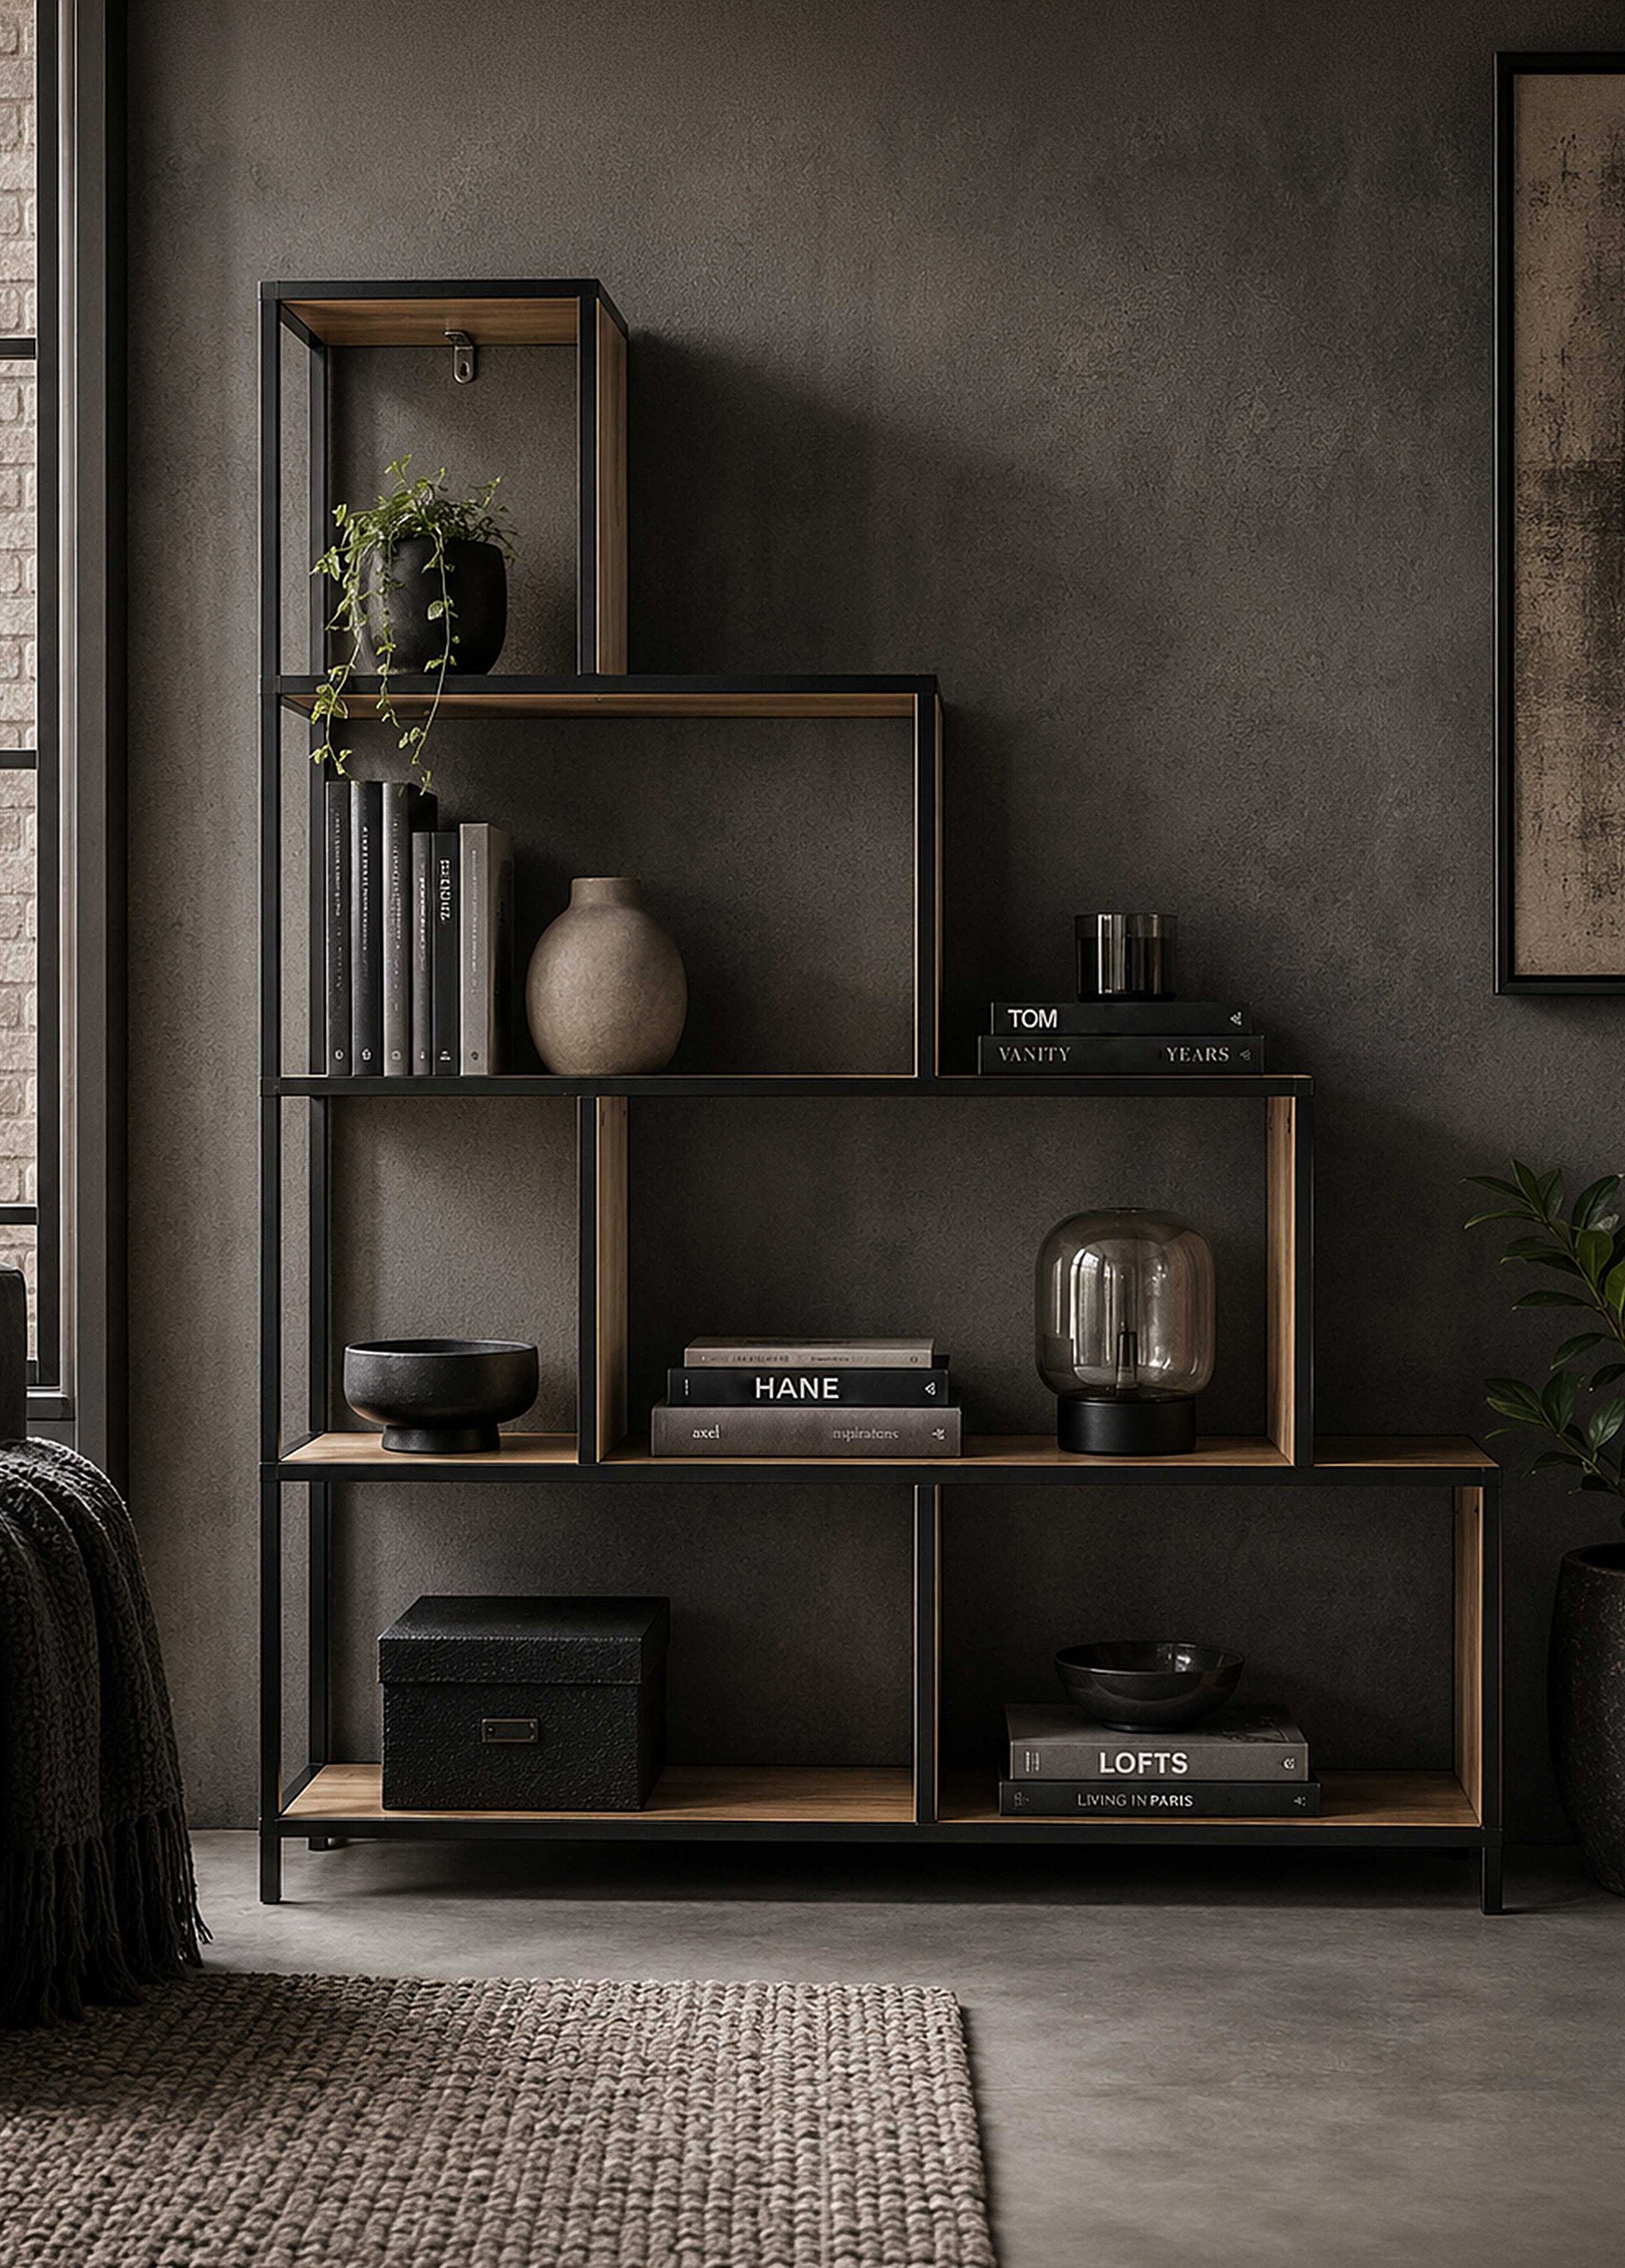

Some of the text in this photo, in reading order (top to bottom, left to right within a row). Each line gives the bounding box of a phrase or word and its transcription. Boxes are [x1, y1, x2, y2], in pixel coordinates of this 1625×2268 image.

[1007, 1008, 1058, 1029] TOM
[999, 1046, 1230, 1062] VANITY YEARS
[755, 1377, 840, 1399] HANE
[691, 1425, 721, 1440] axel
[1098, 1751, 1189, 1774] LOFTS
[1077, 1794, 1194, 1807] LIVING IN PARIS
